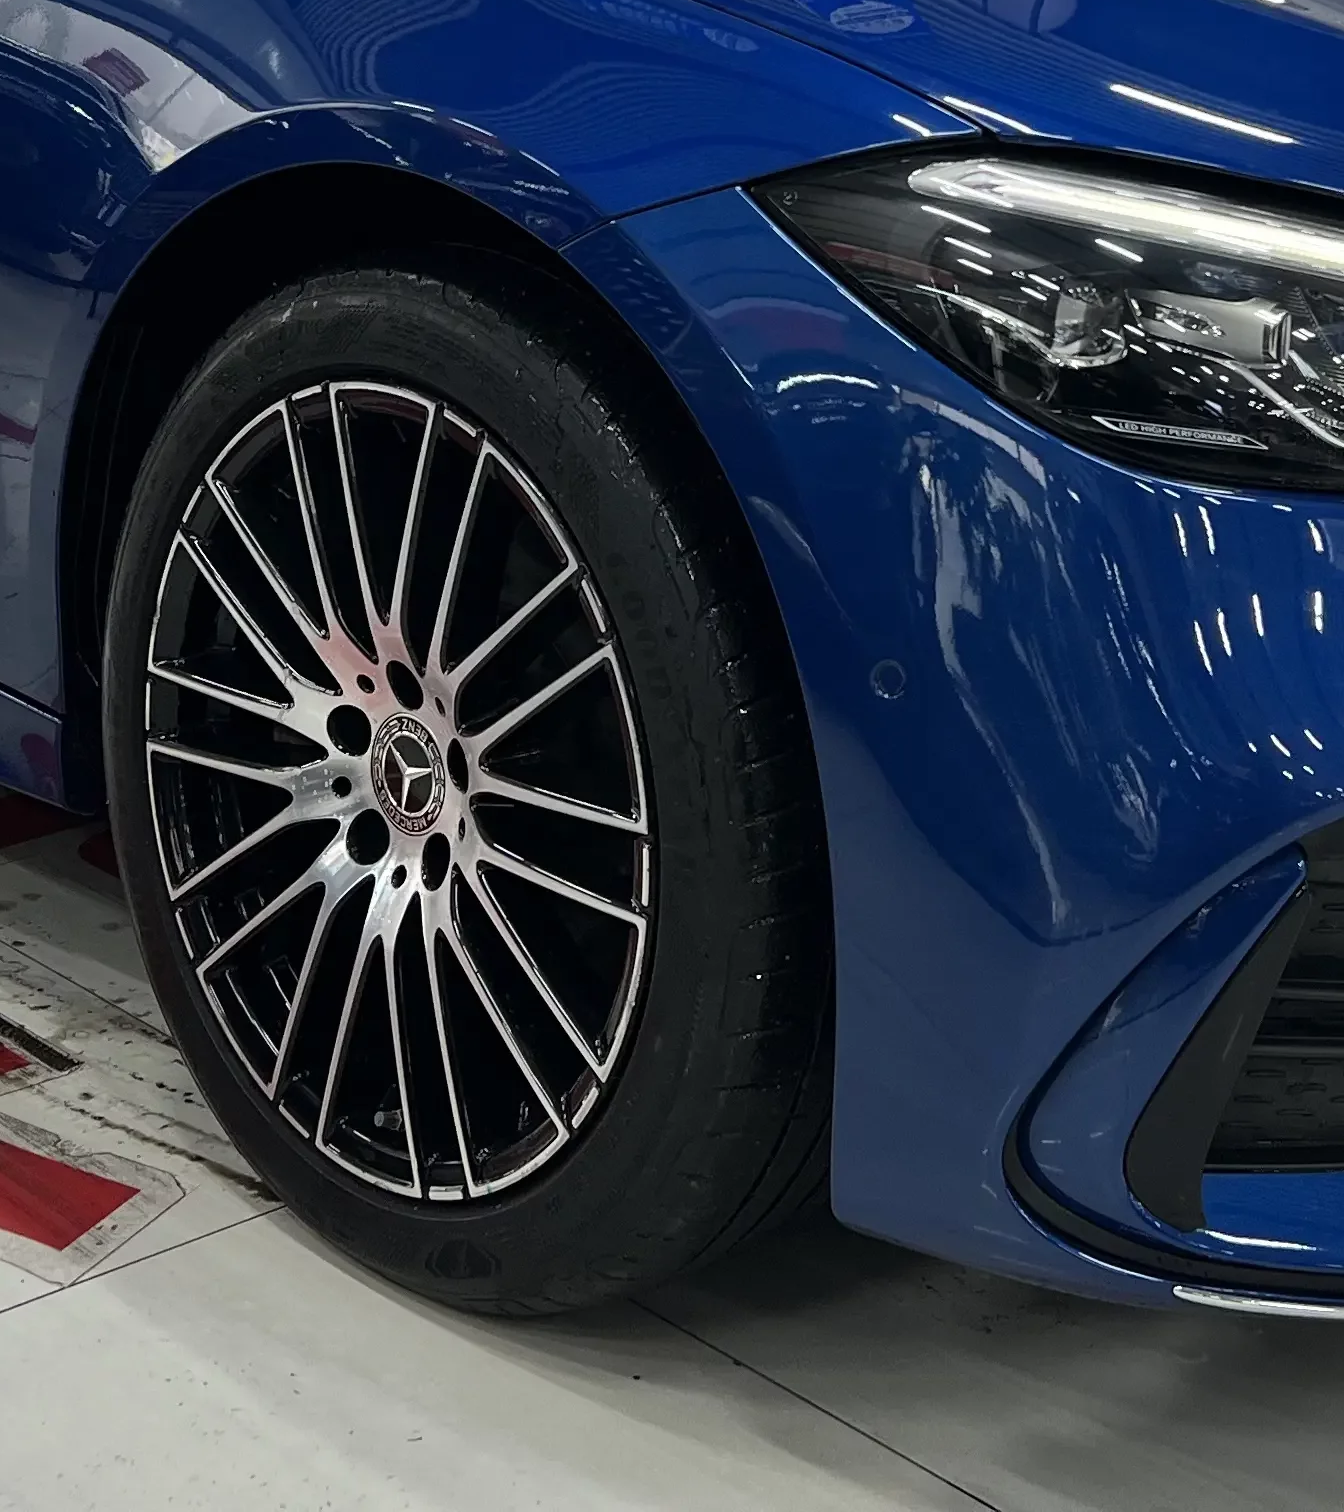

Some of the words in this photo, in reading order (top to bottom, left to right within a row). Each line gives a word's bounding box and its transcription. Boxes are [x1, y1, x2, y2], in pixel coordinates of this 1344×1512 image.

[1118, 421, 1138, 433] LED
[1140, 424, 1167, 436] HIGH
[1168, 427, 1244, 445] PERFORMANCE
[401, 718, 429, 742] BENZ
